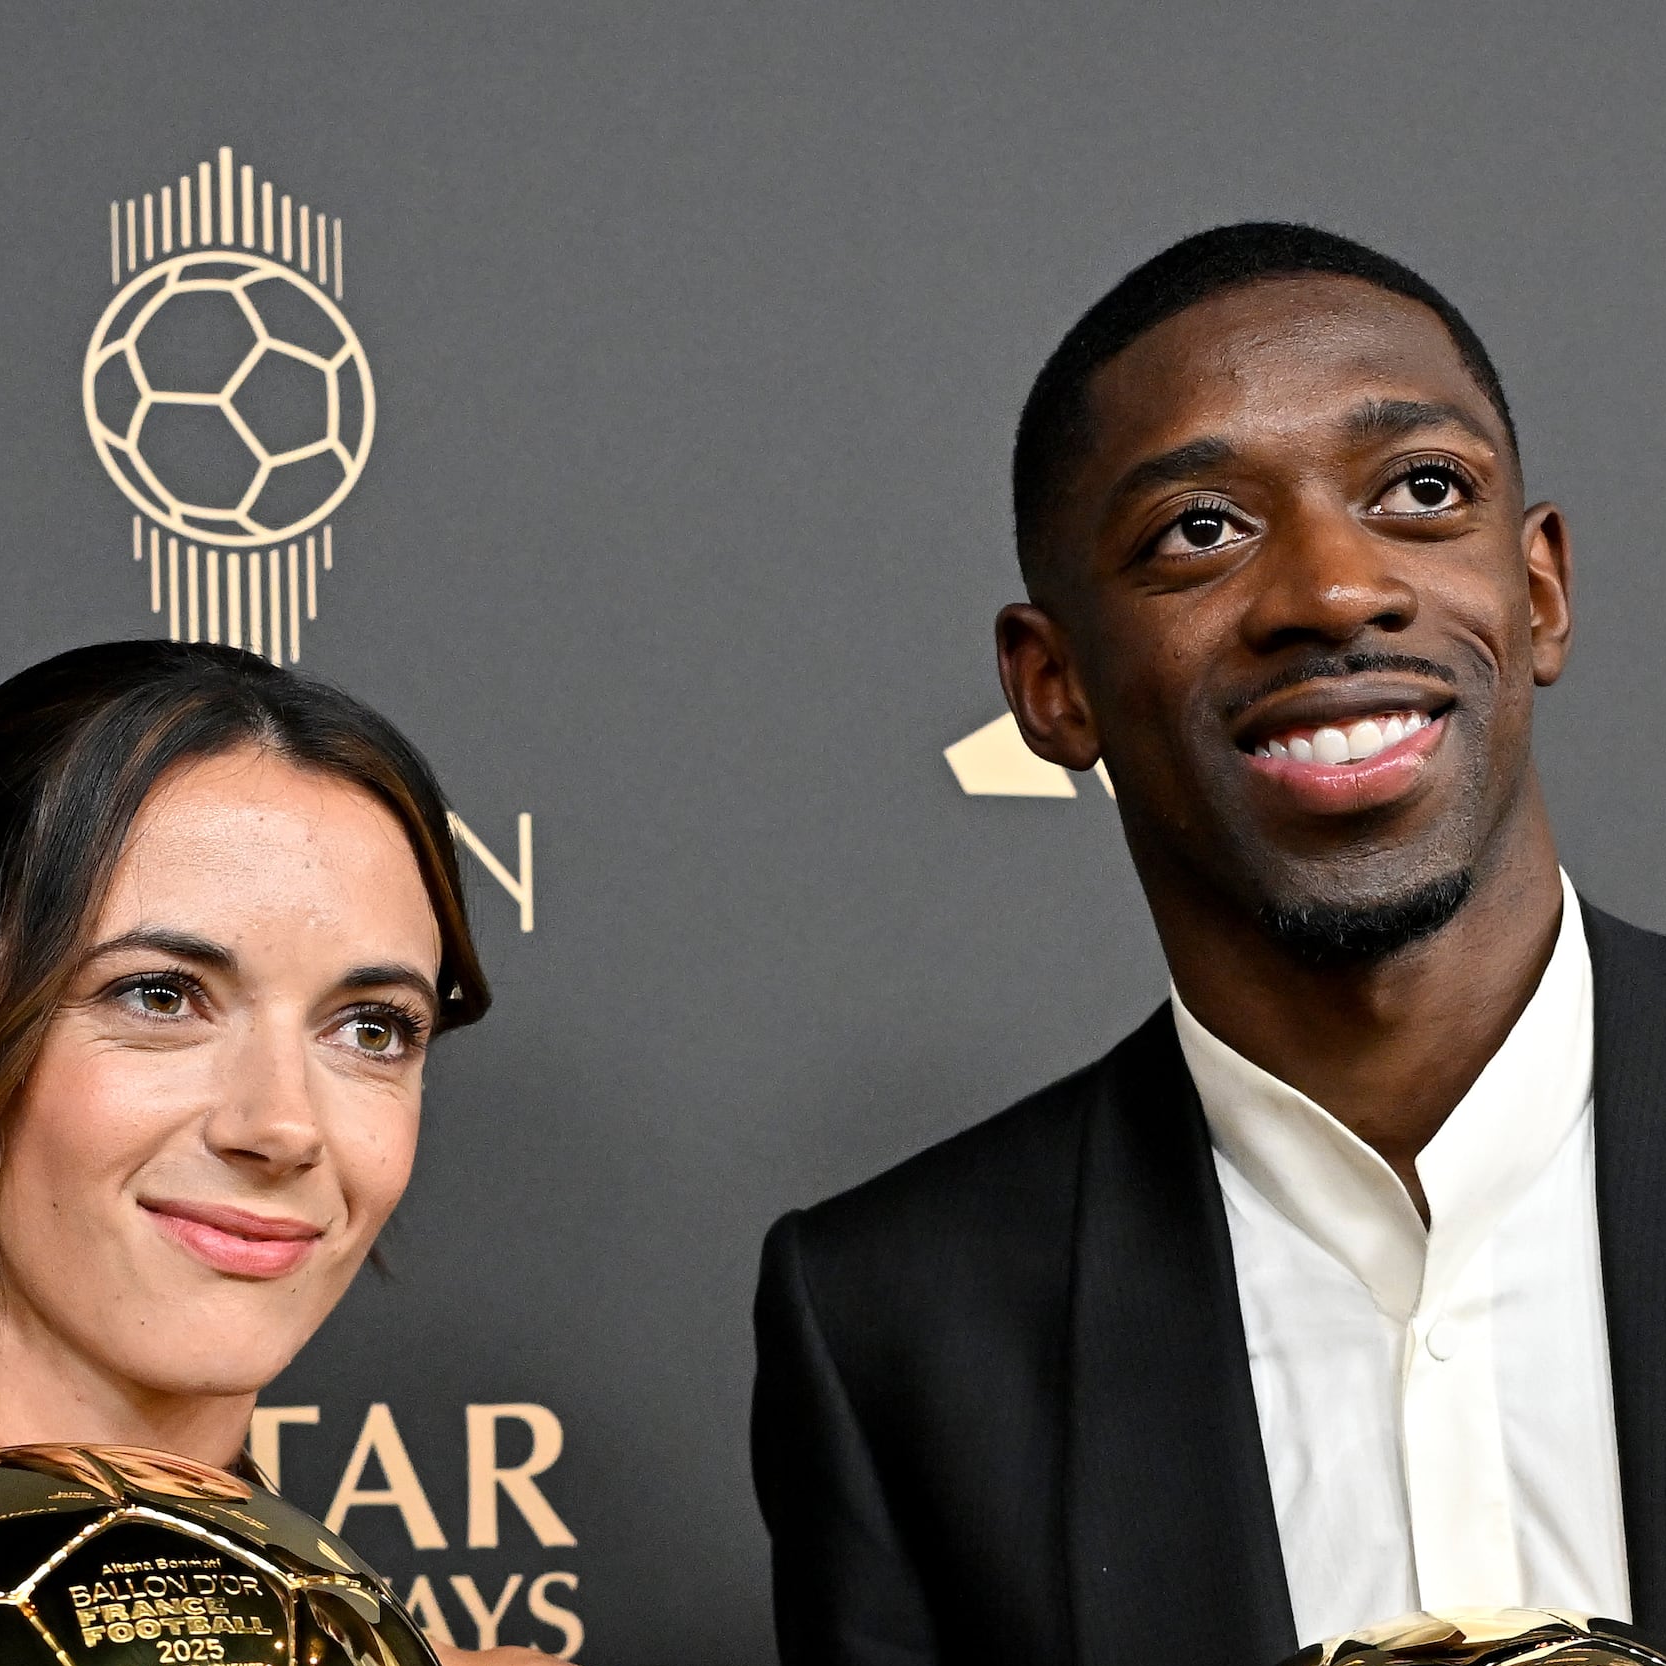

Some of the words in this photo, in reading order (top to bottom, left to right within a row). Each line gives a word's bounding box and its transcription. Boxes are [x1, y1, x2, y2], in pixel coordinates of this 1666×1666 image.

[248, 1402, 579, 1551] TAR
[68, 1574, 189, 1608] BALLON
[192, 1574, 264, 1597] D'OR
[75, 1596, 230, 1629] FRANCE
[81, 1615, 274, 1649] FOOTBALL
[155, 1638, 226, 1665] 2025
